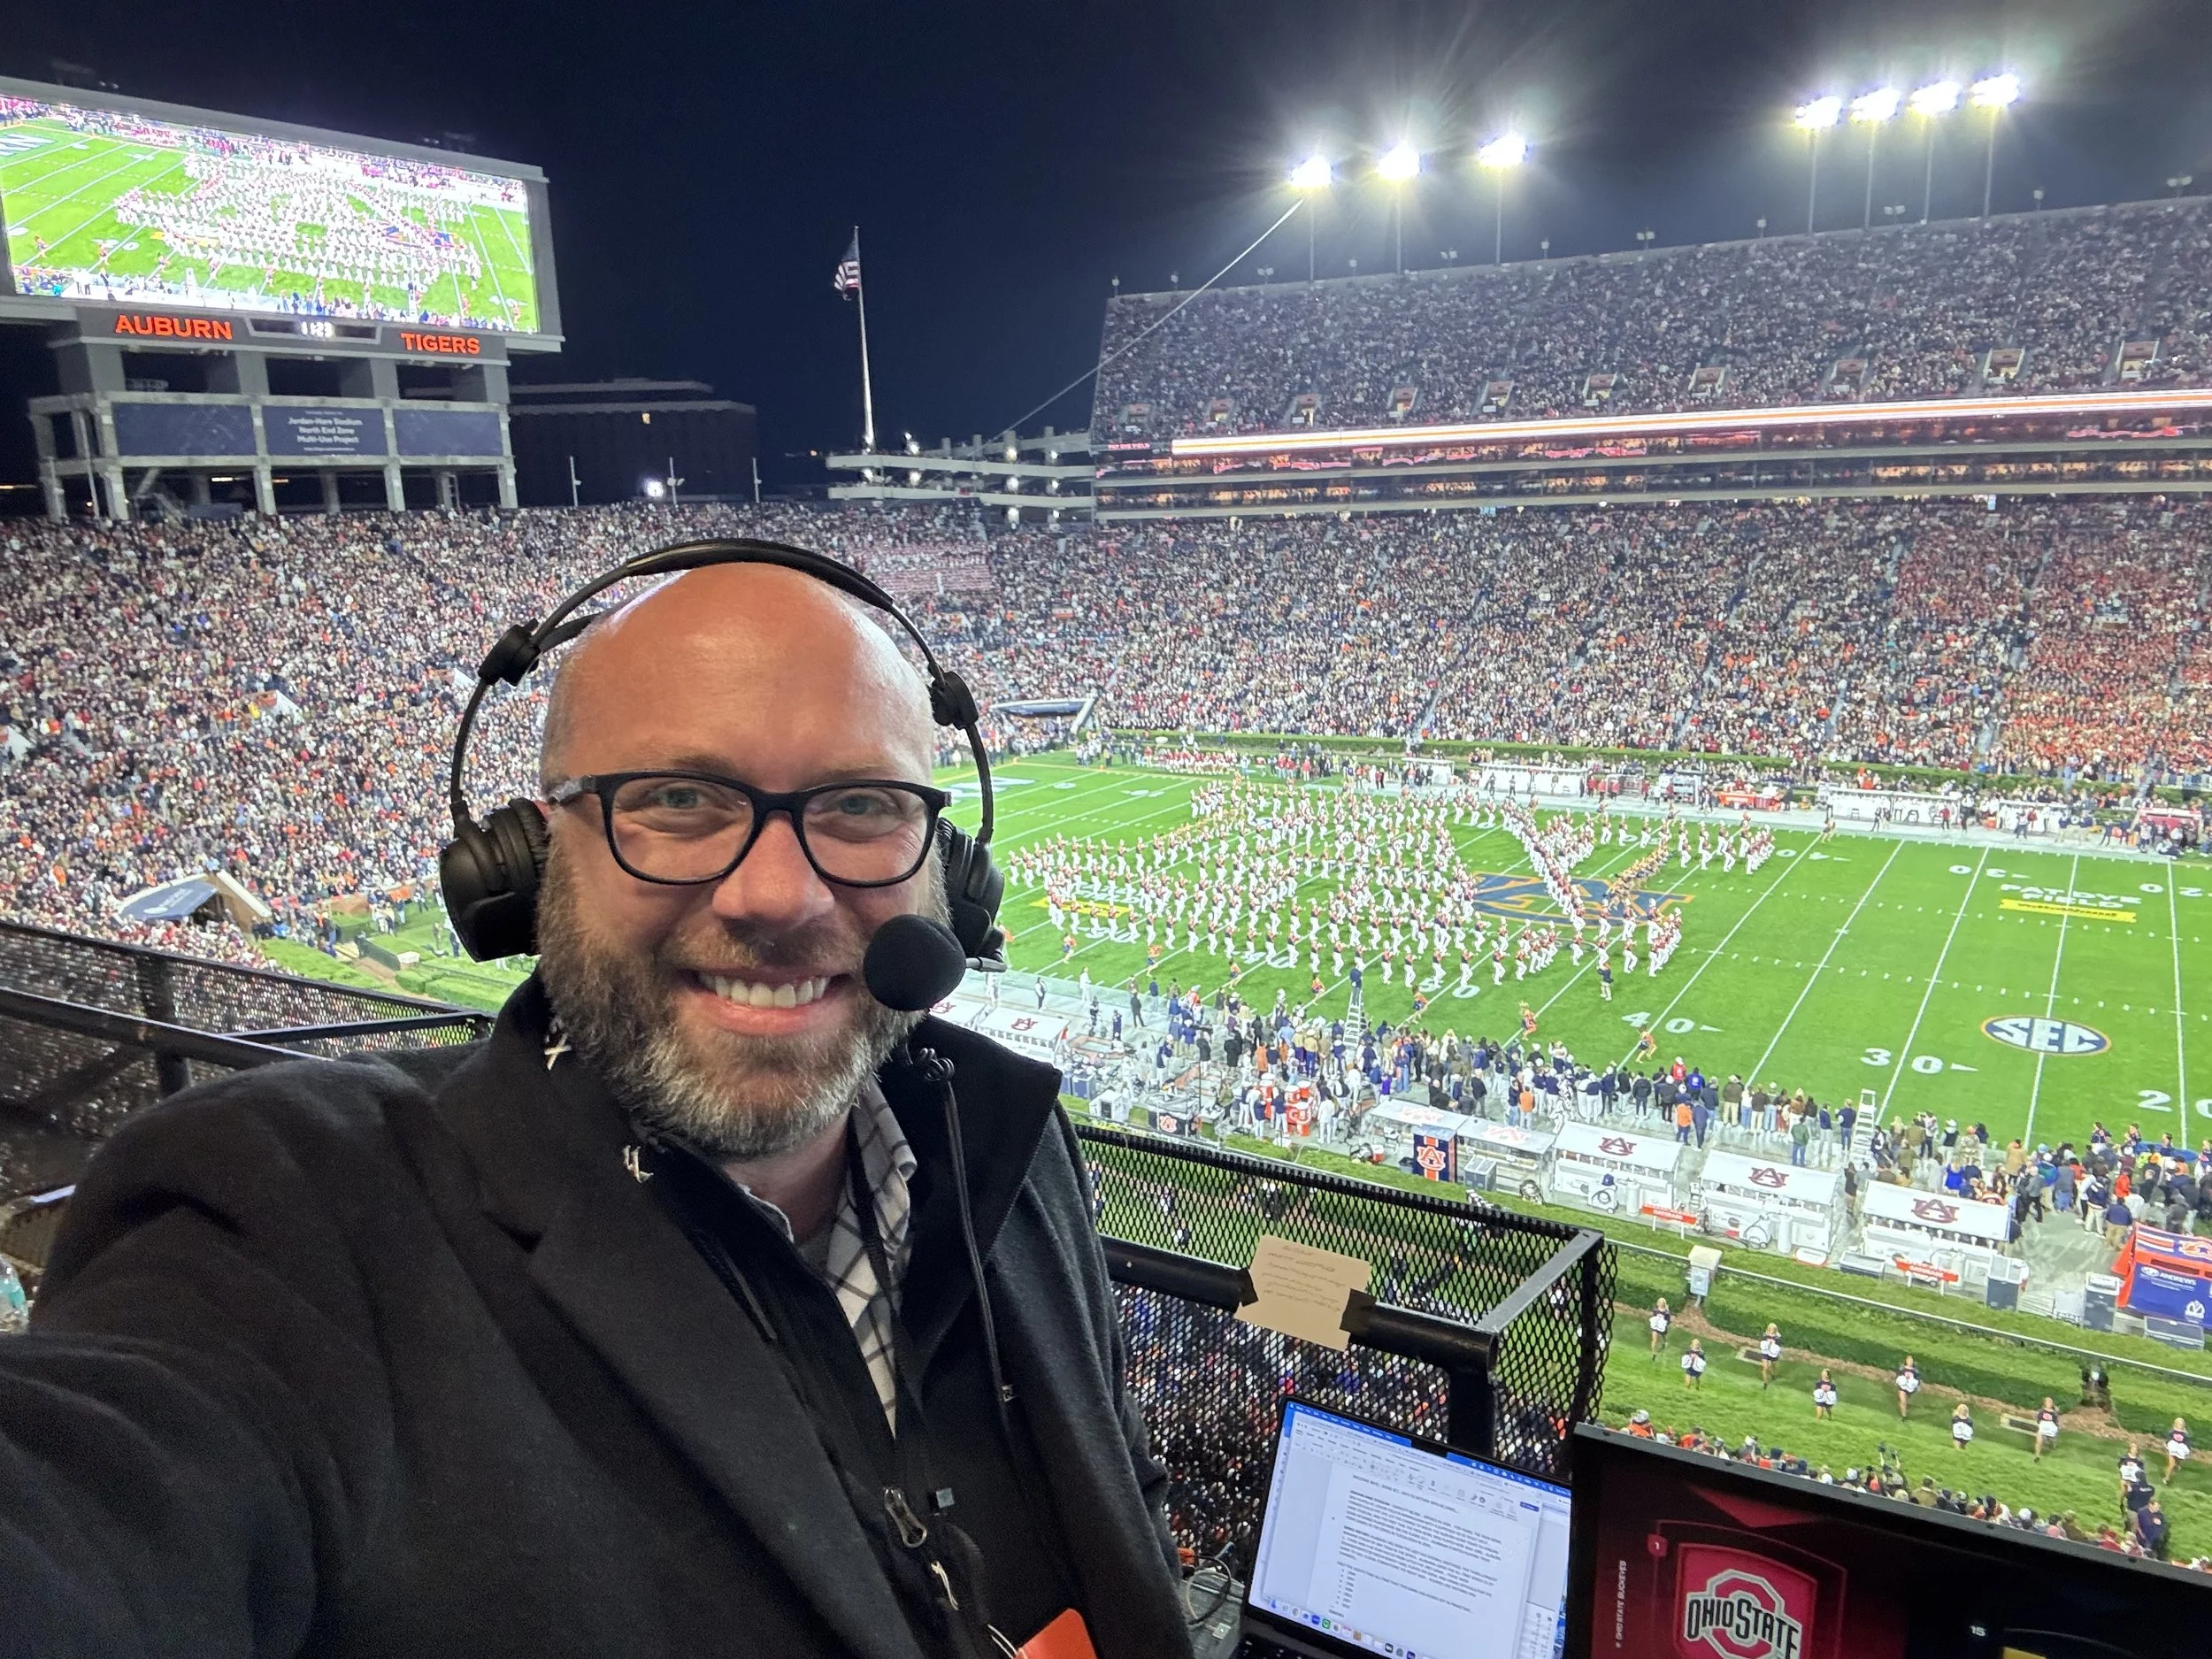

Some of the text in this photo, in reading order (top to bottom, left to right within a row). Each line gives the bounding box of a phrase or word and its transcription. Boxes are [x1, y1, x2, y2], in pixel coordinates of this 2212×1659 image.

[115, 314, 234, 340] AUBURN
[400, 332, 480, 354] TIGERS
[1987, 1017, 2101, 1054] SEC
[1861, 1048, 1944, 1074] 30
[1687, 1599, 1734, 1639] OHIO
[1970, 1625, 1986, 1637] 15
